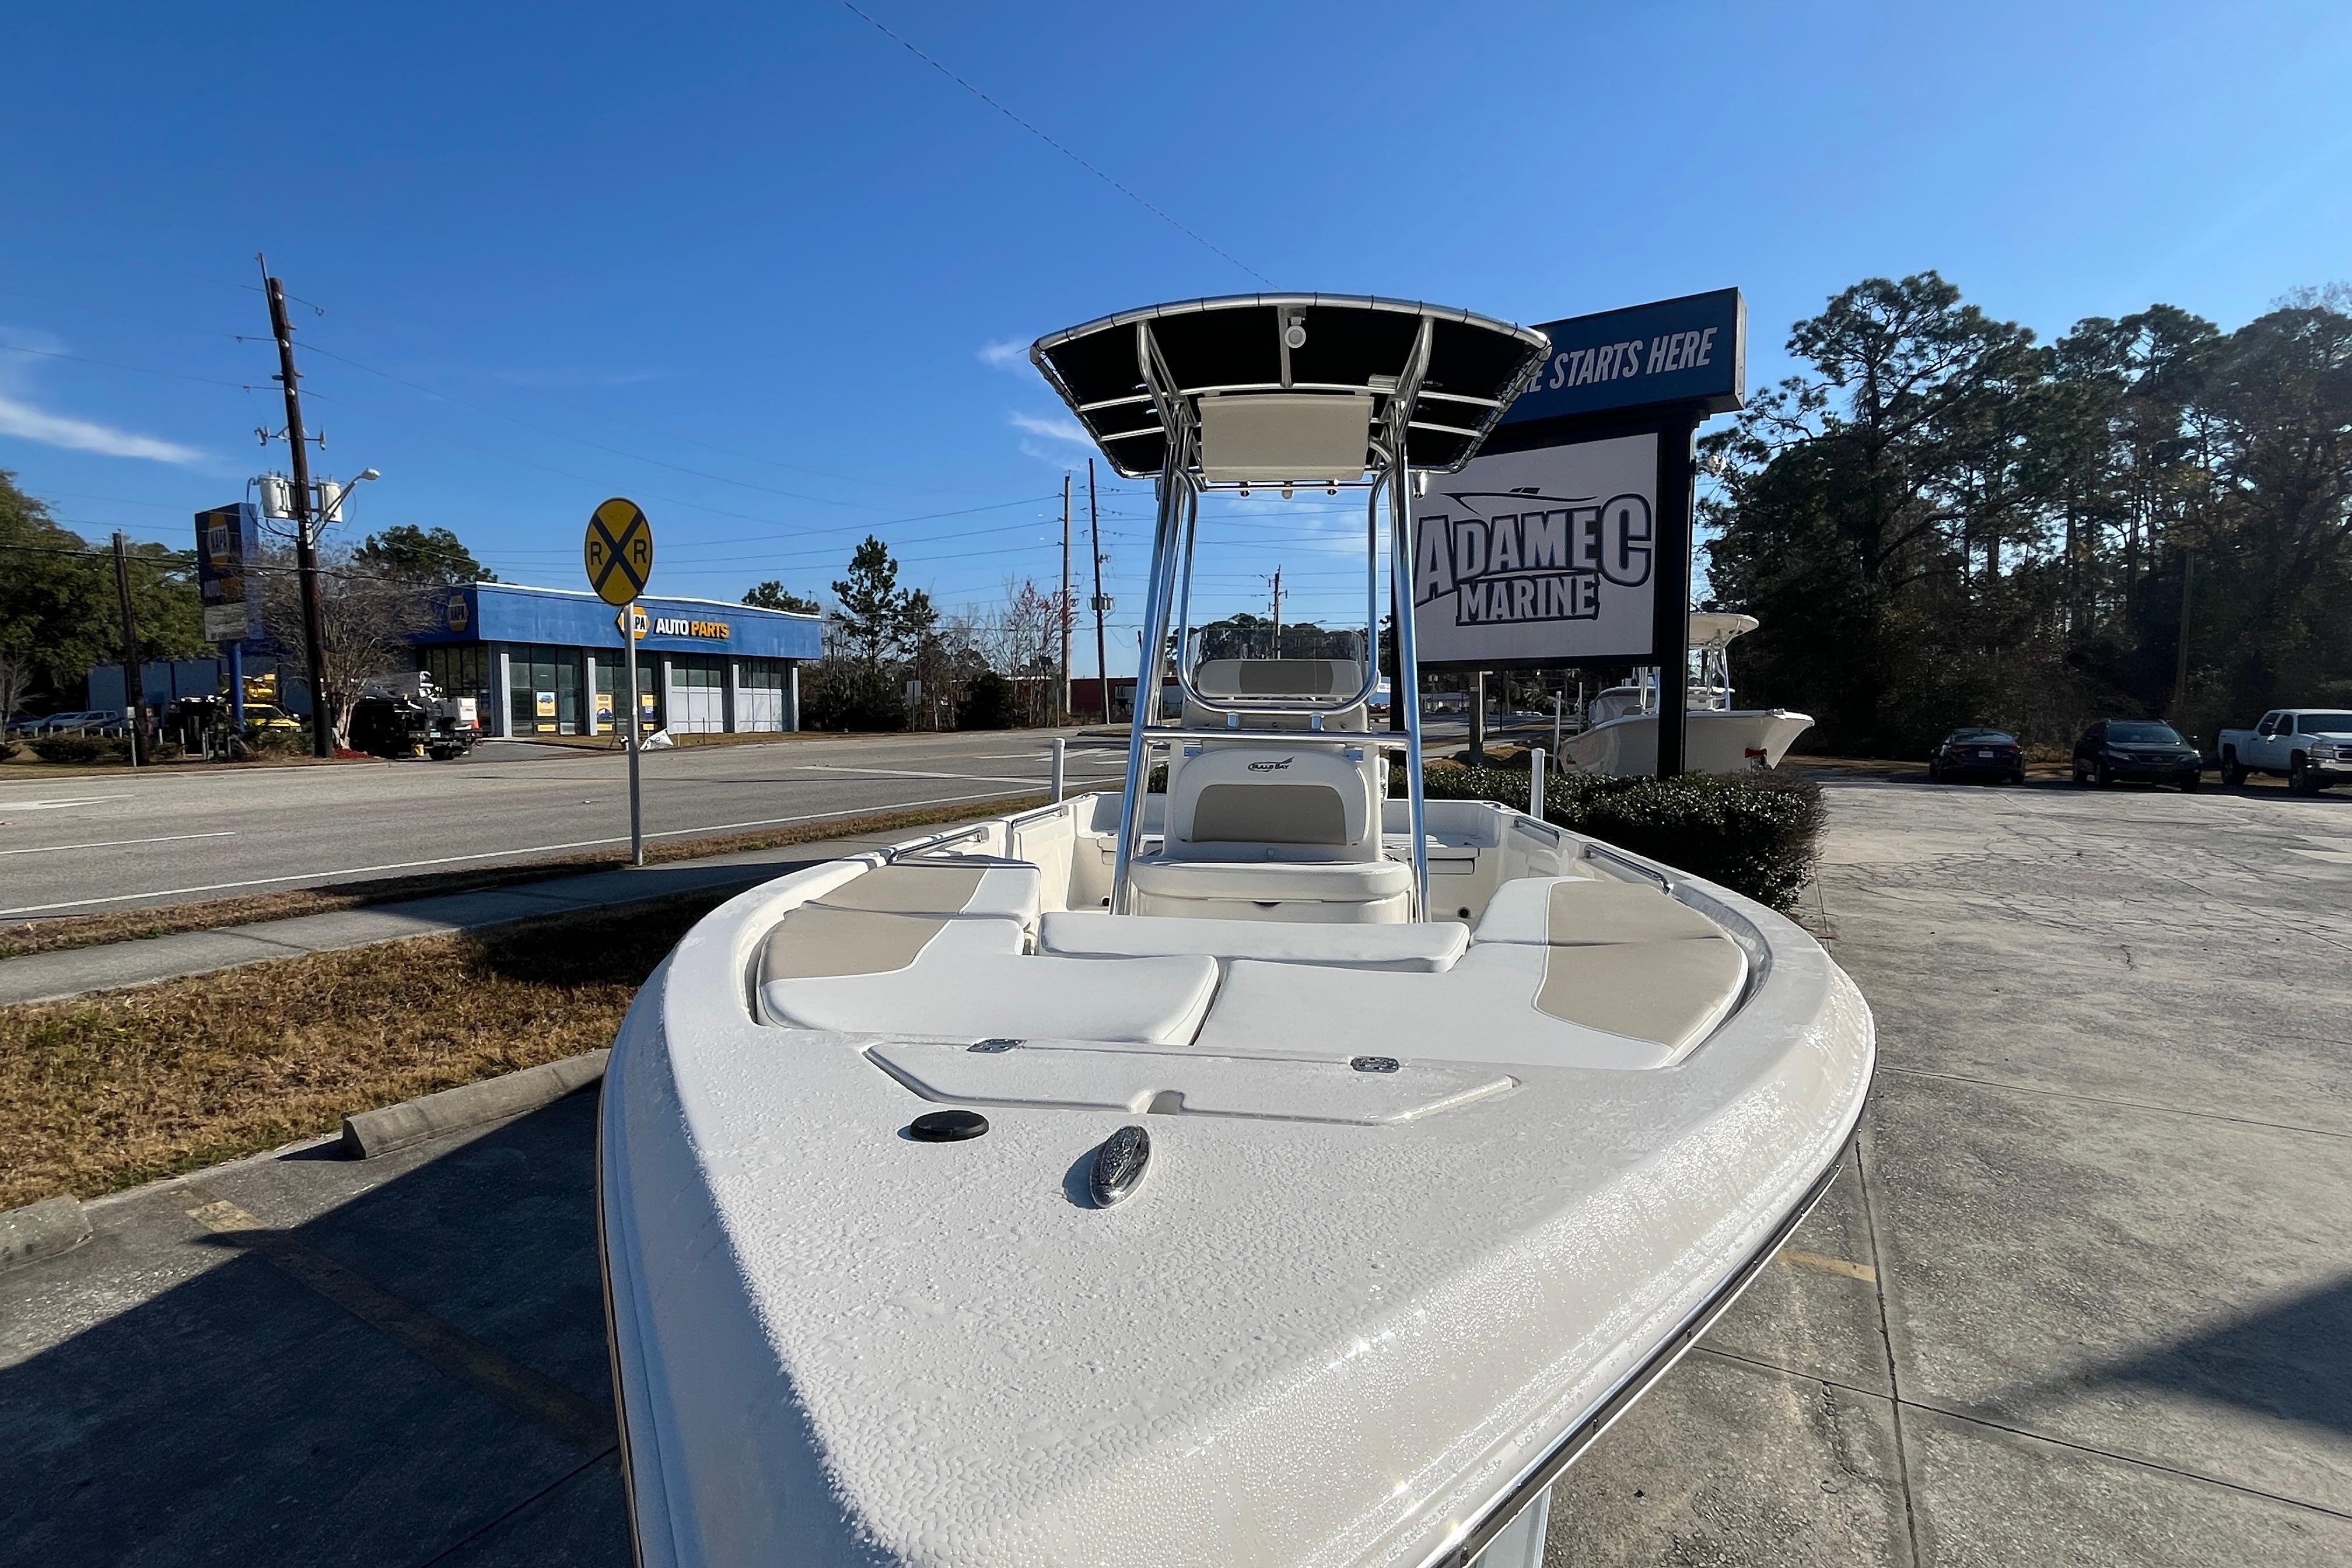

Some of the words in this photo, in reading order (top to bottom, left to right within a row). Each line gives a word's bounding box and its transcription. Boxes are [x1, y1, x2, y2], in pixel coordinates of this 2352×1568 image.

[1550, 340, 1643, 389] STARTS
[1646, 327, 1718, 376] HERE
[590, 541, 603, 566] R
[634, 538, 647, 565] R
[1414, 493, 1652, 608] ADAMEC
[1457, 572, 1600, 626] MARINE
[654, 618, 690, 636] AUTO
[691, 621, 730, 639] PARTS
